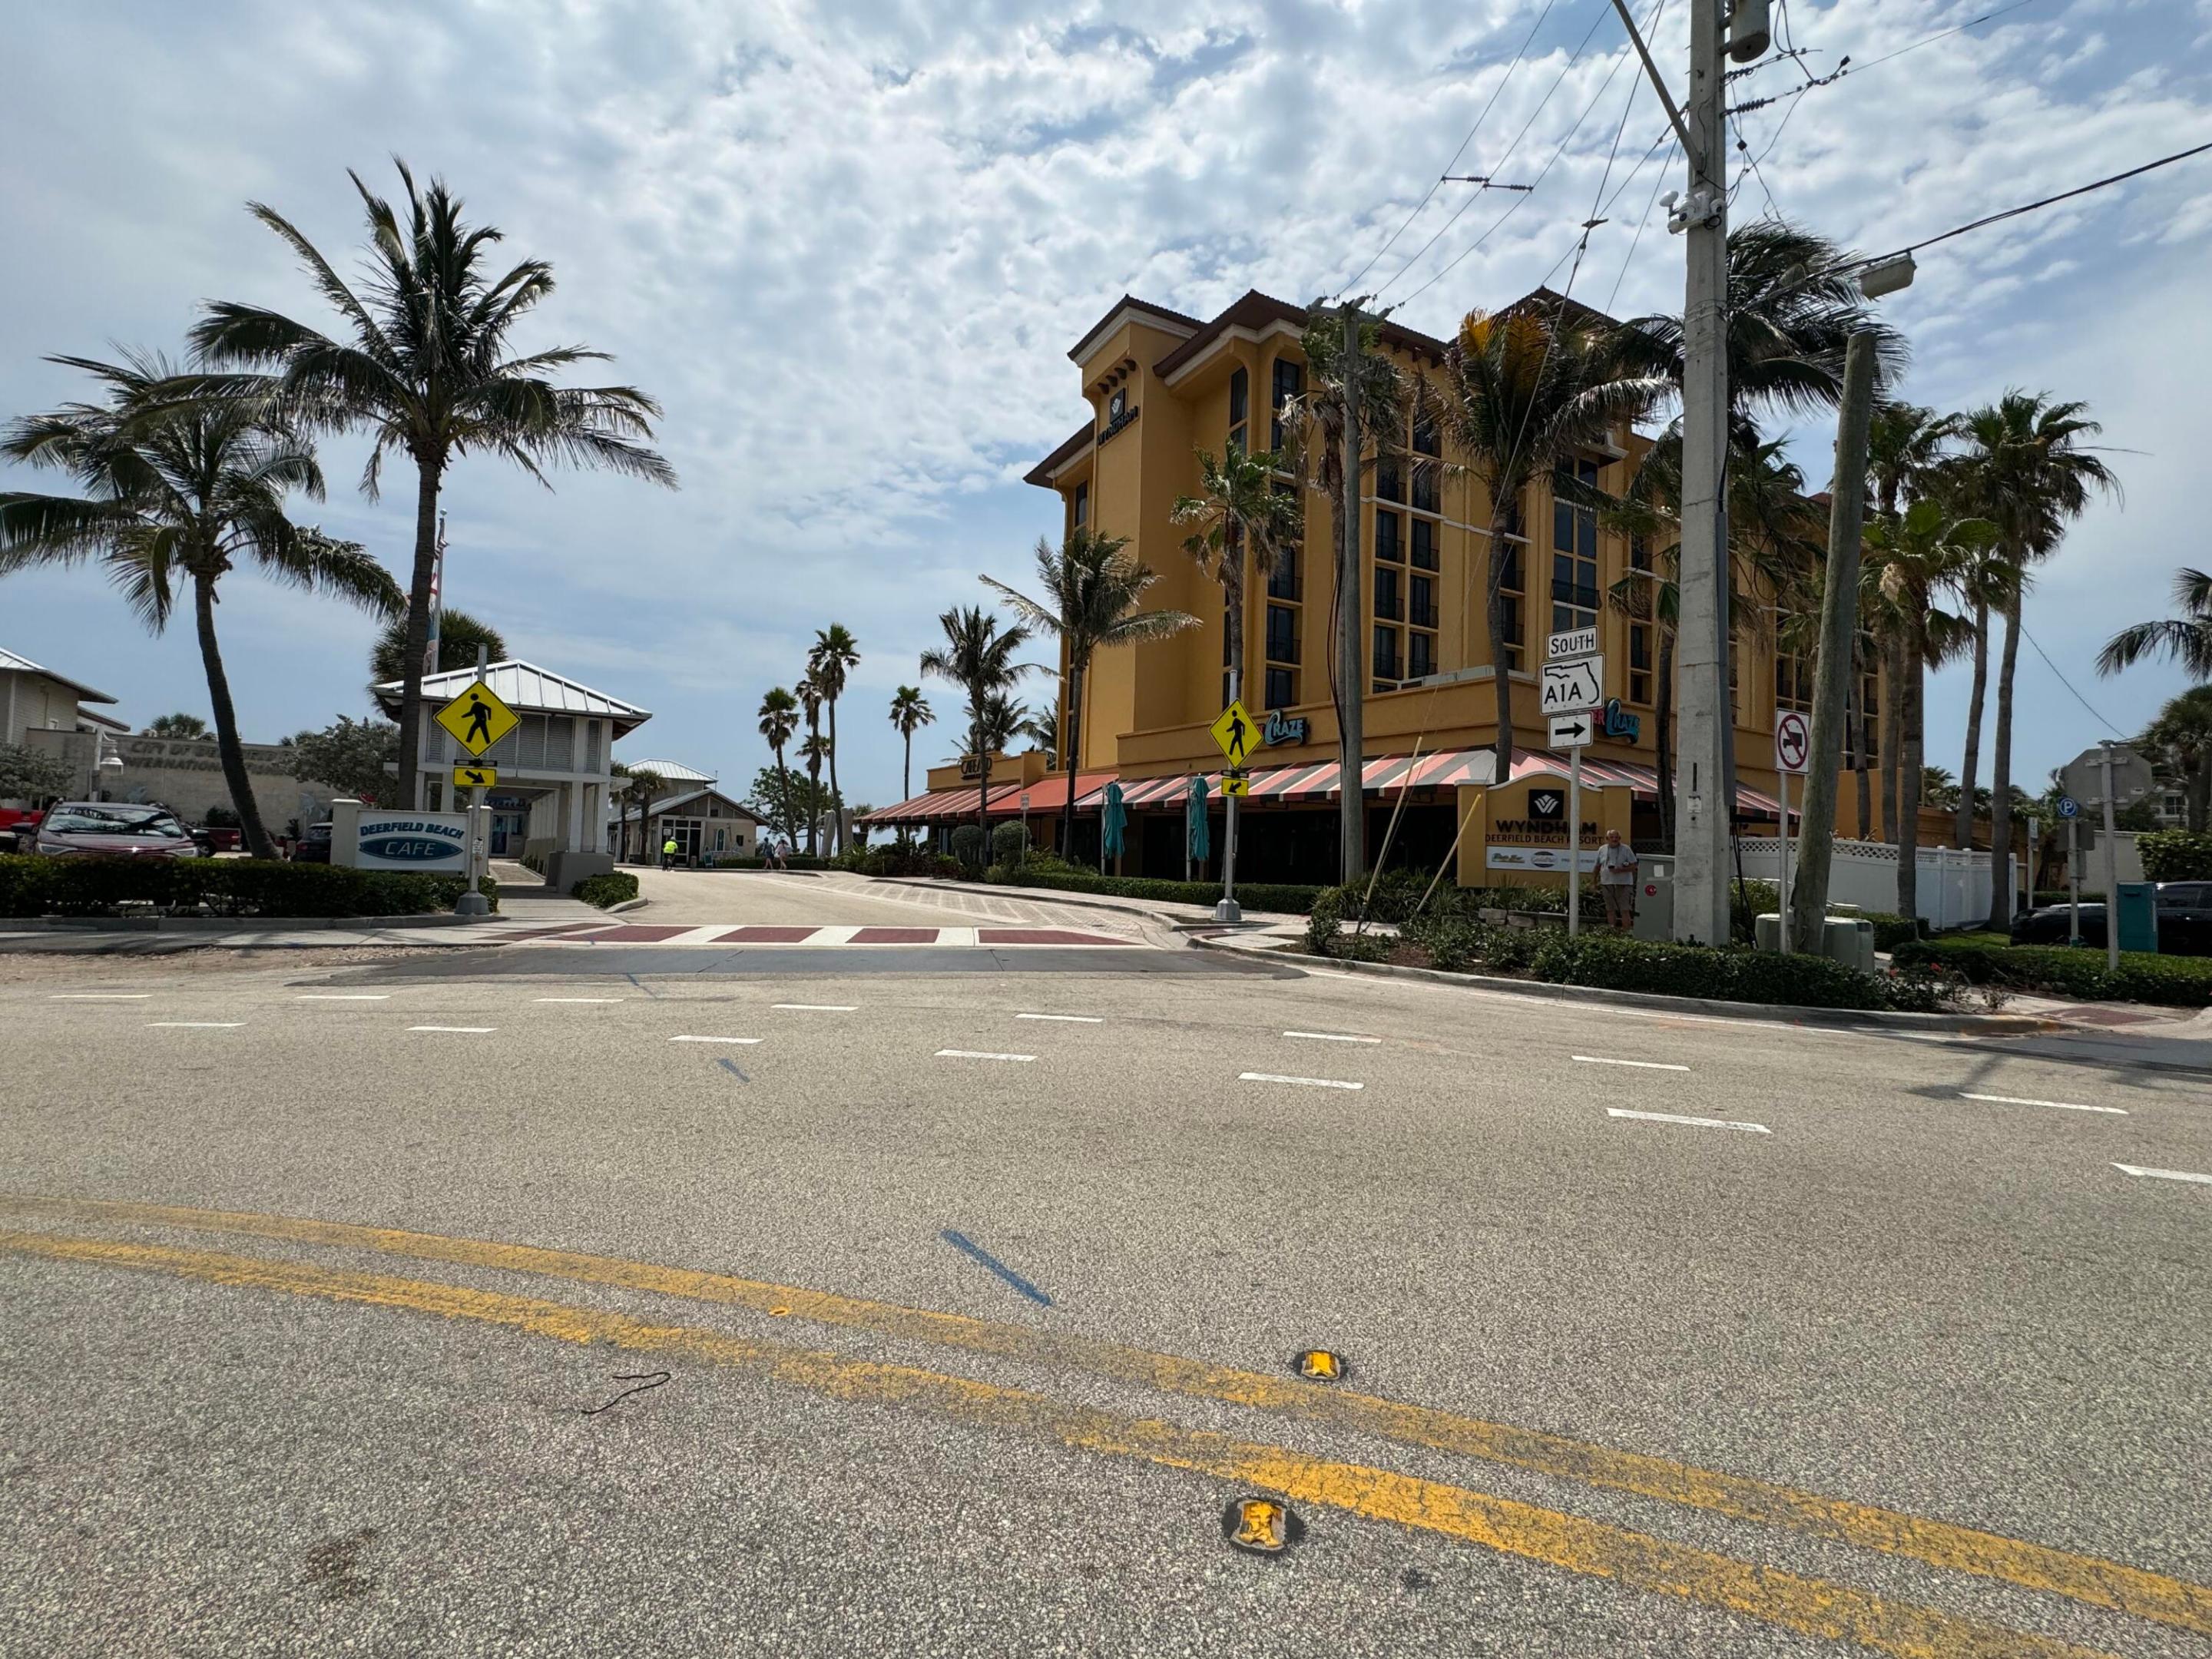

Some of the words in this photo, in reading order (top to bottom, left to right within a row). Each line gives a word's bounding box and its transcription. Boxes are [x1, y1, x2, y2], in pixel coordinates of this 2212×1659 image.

[1550, 633, 1594, 654] SOUTH
[1544, 681, 1582, 704] A1A
[359, 822, 424, 836] DEERFIELD
[425, 823, 465, 839] BEACH
[1495, 820, 1598, 835] WYNDHM
[1485, 834, 1532, 843] DEERFIELD
[1534, 835, 1564, 844] BEACH
[385, 841, 438, 856] CAFE
